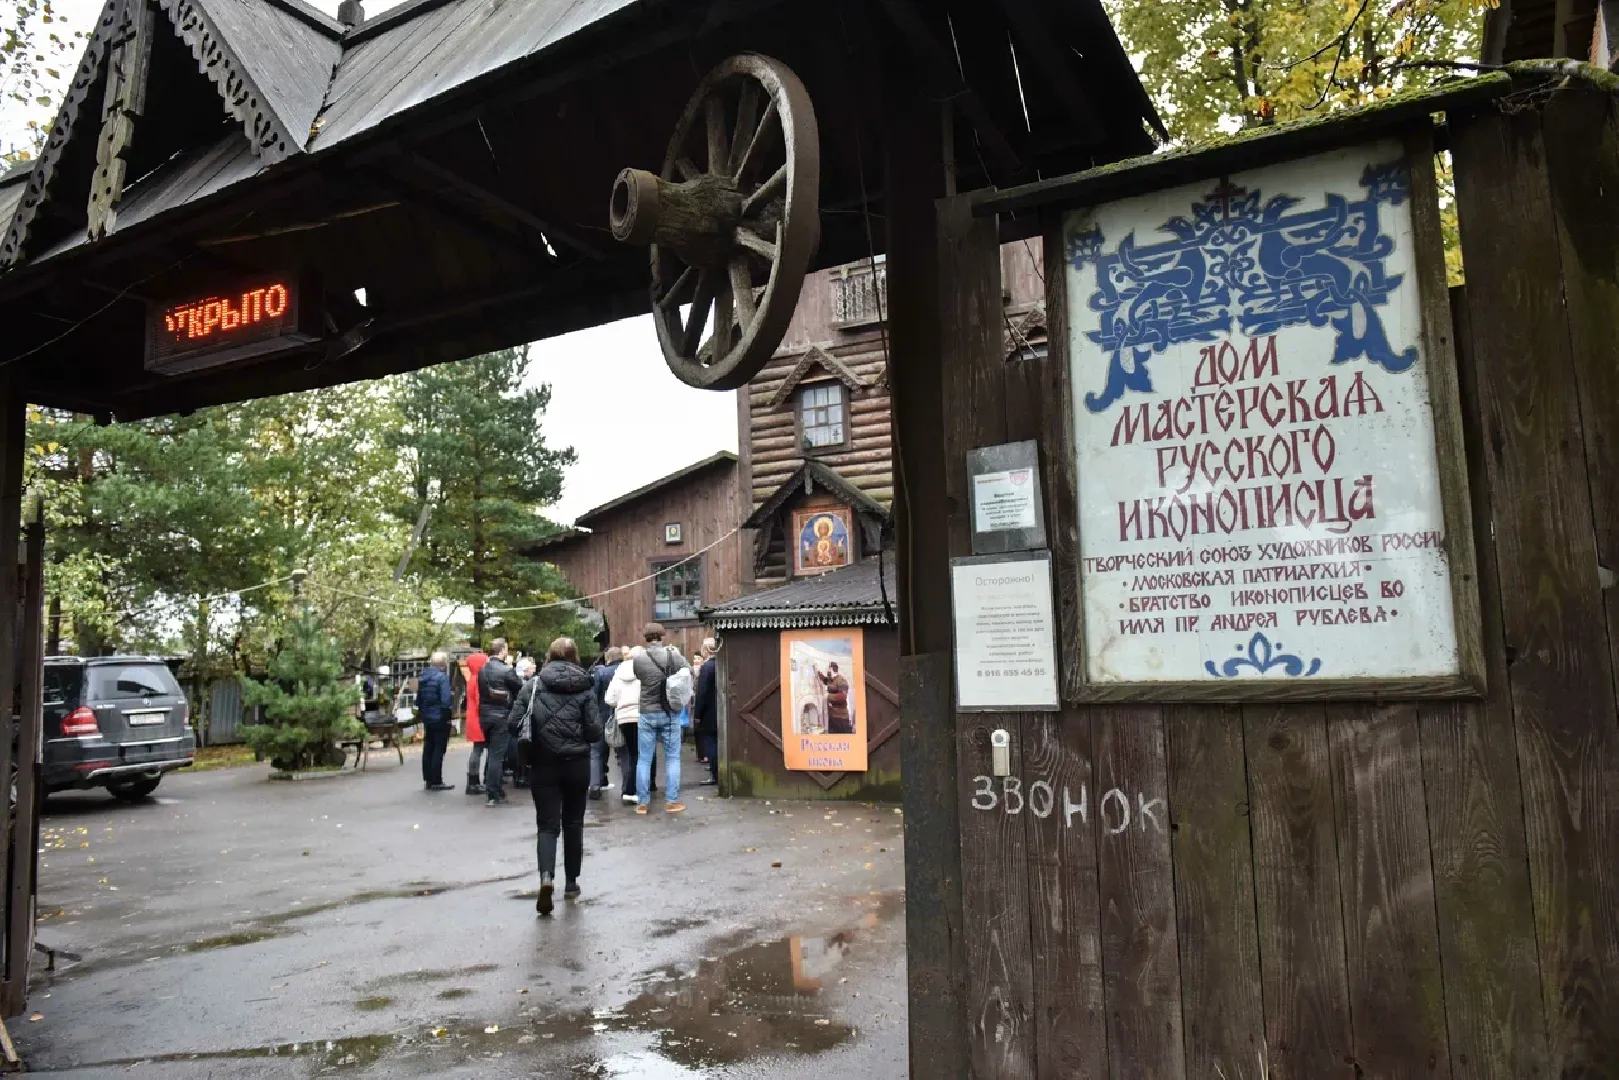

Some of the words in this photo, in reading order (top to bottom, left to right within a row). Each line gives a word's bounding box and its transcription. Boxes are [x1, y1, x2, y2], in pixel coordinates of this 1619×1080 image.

[1194, 336, 1279, 386] ДОМ
[1156, 424, 1336, 494] РУССКОГО
[1118, 475, 1376, 542] ИКОНОПИСЦА
[1082, 547, 1195, 573] ТВОРЧЕСКИЙ
[1200, 546, 1252, 565] СОЮЗ
[1257, 535, 1373, 561] ХУДОЖНИКОВ
[975, 573, 1035, 587] Осторожно!
[1131, 569, 1235, 591] МОСКОВСКАЯ
[1242, 561, 1361, 584] ПАТРИАРХИЯ
[1129, 593, 1211, 613] БРАТСТВО
[1230, 582, 1369, 607] ИКОНОПИСЦЕВ
[1381, 579, 1405, 599] ВО
[1119, 617, 1165, 634] ИМЯ
[971, 775, 1167, 834] ЗВОНОК
